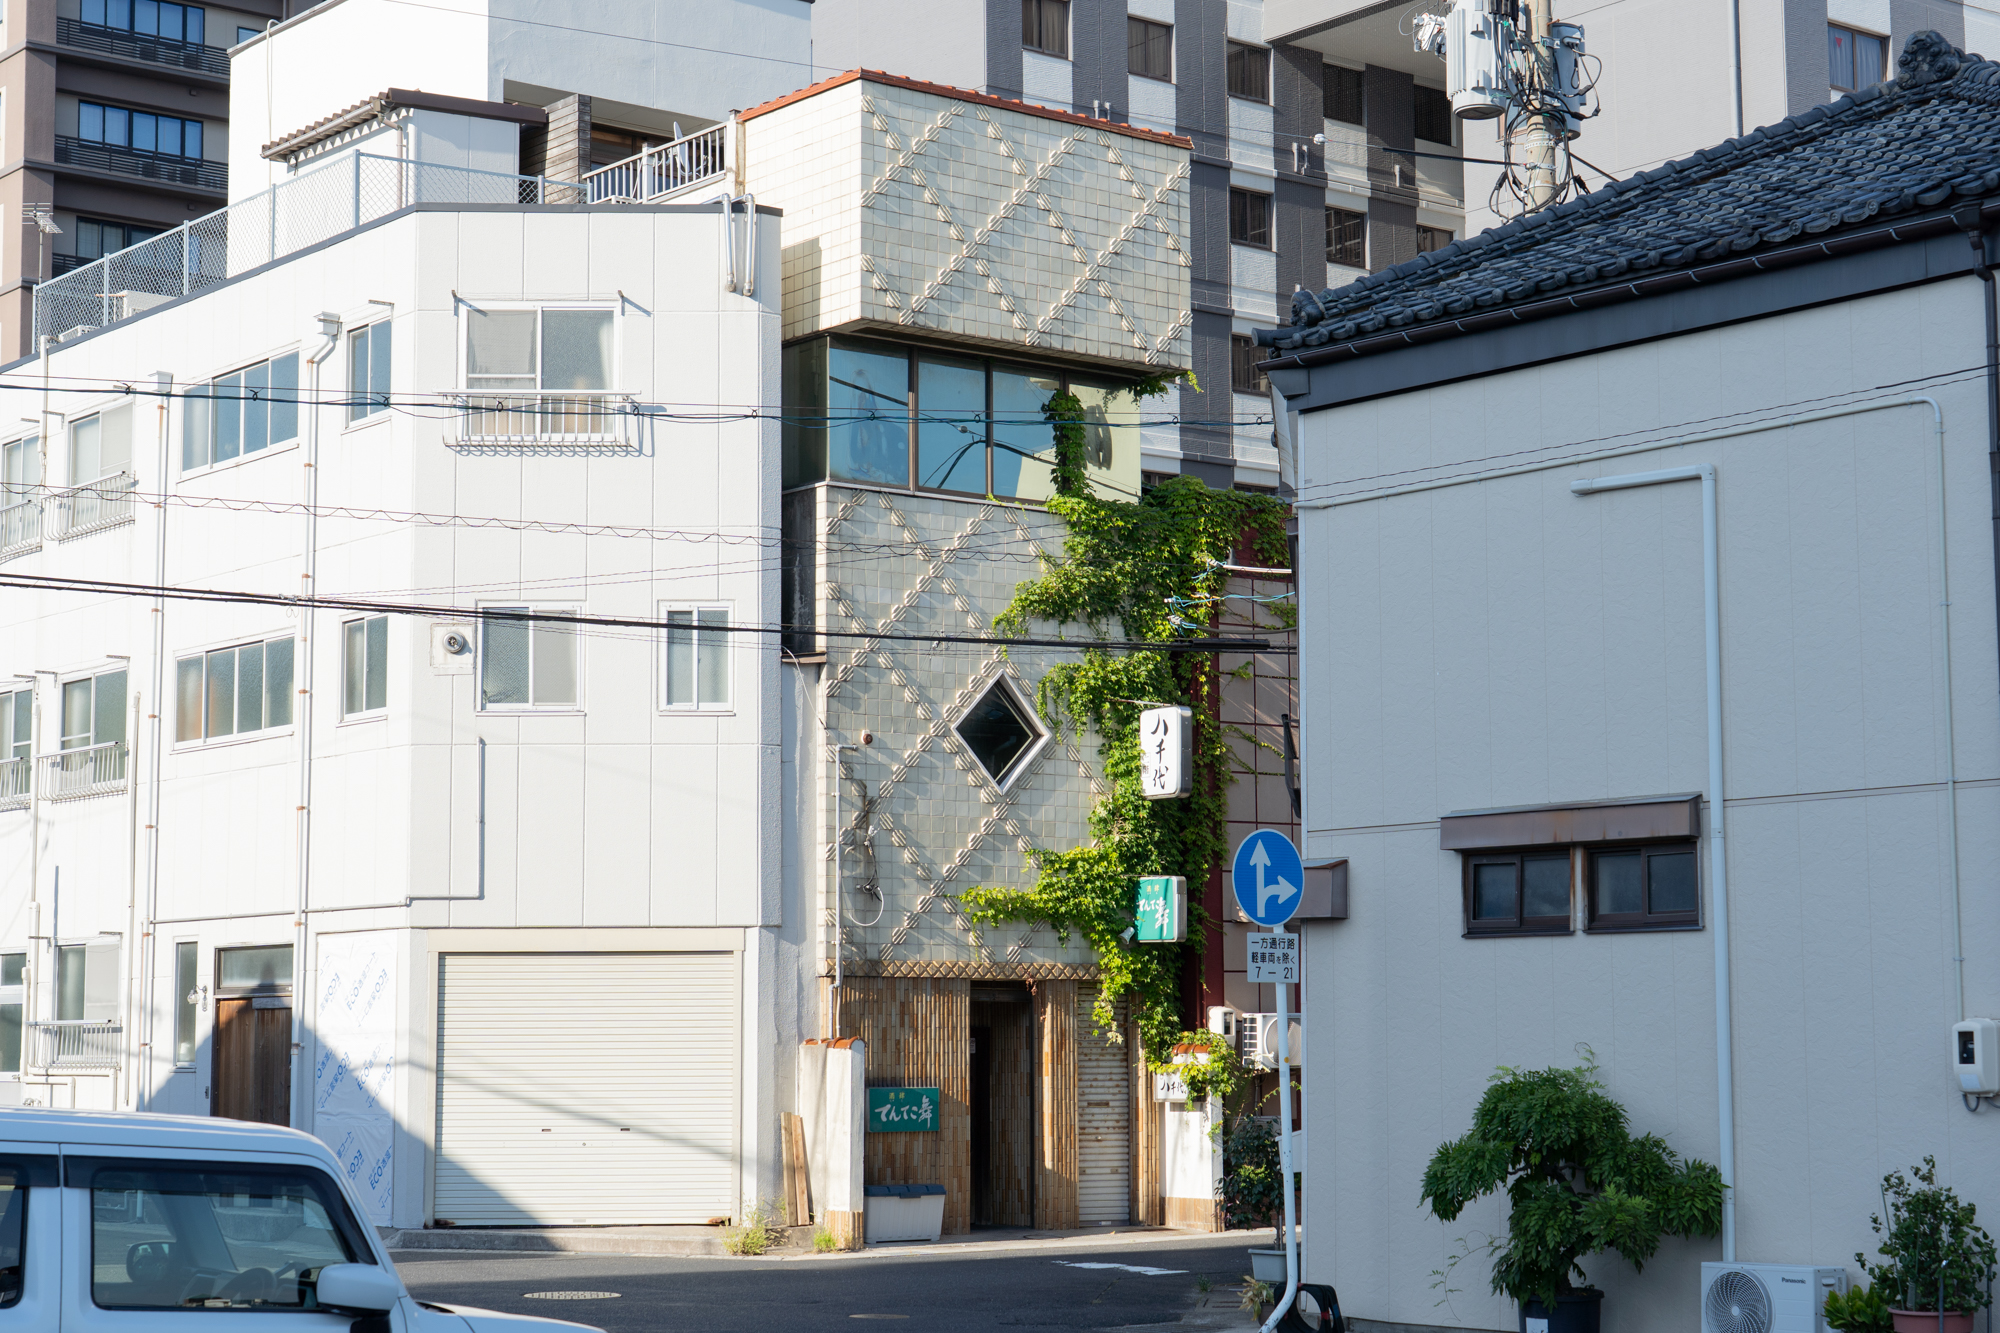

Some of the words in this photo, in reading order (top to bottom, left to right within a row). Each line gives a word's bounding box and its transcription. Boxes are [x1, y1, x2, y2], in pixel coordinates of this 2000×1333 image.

[1151, 714, 1169, 790] 八千代
[1136, 897, 1170, 937] てんてこ舞
[1251, 937, 1295, 950] 一方通行路
[1251, 951, 1295, 965] 軽車両を除く
[874, 1095, 933, 1129] てんてこ舞
